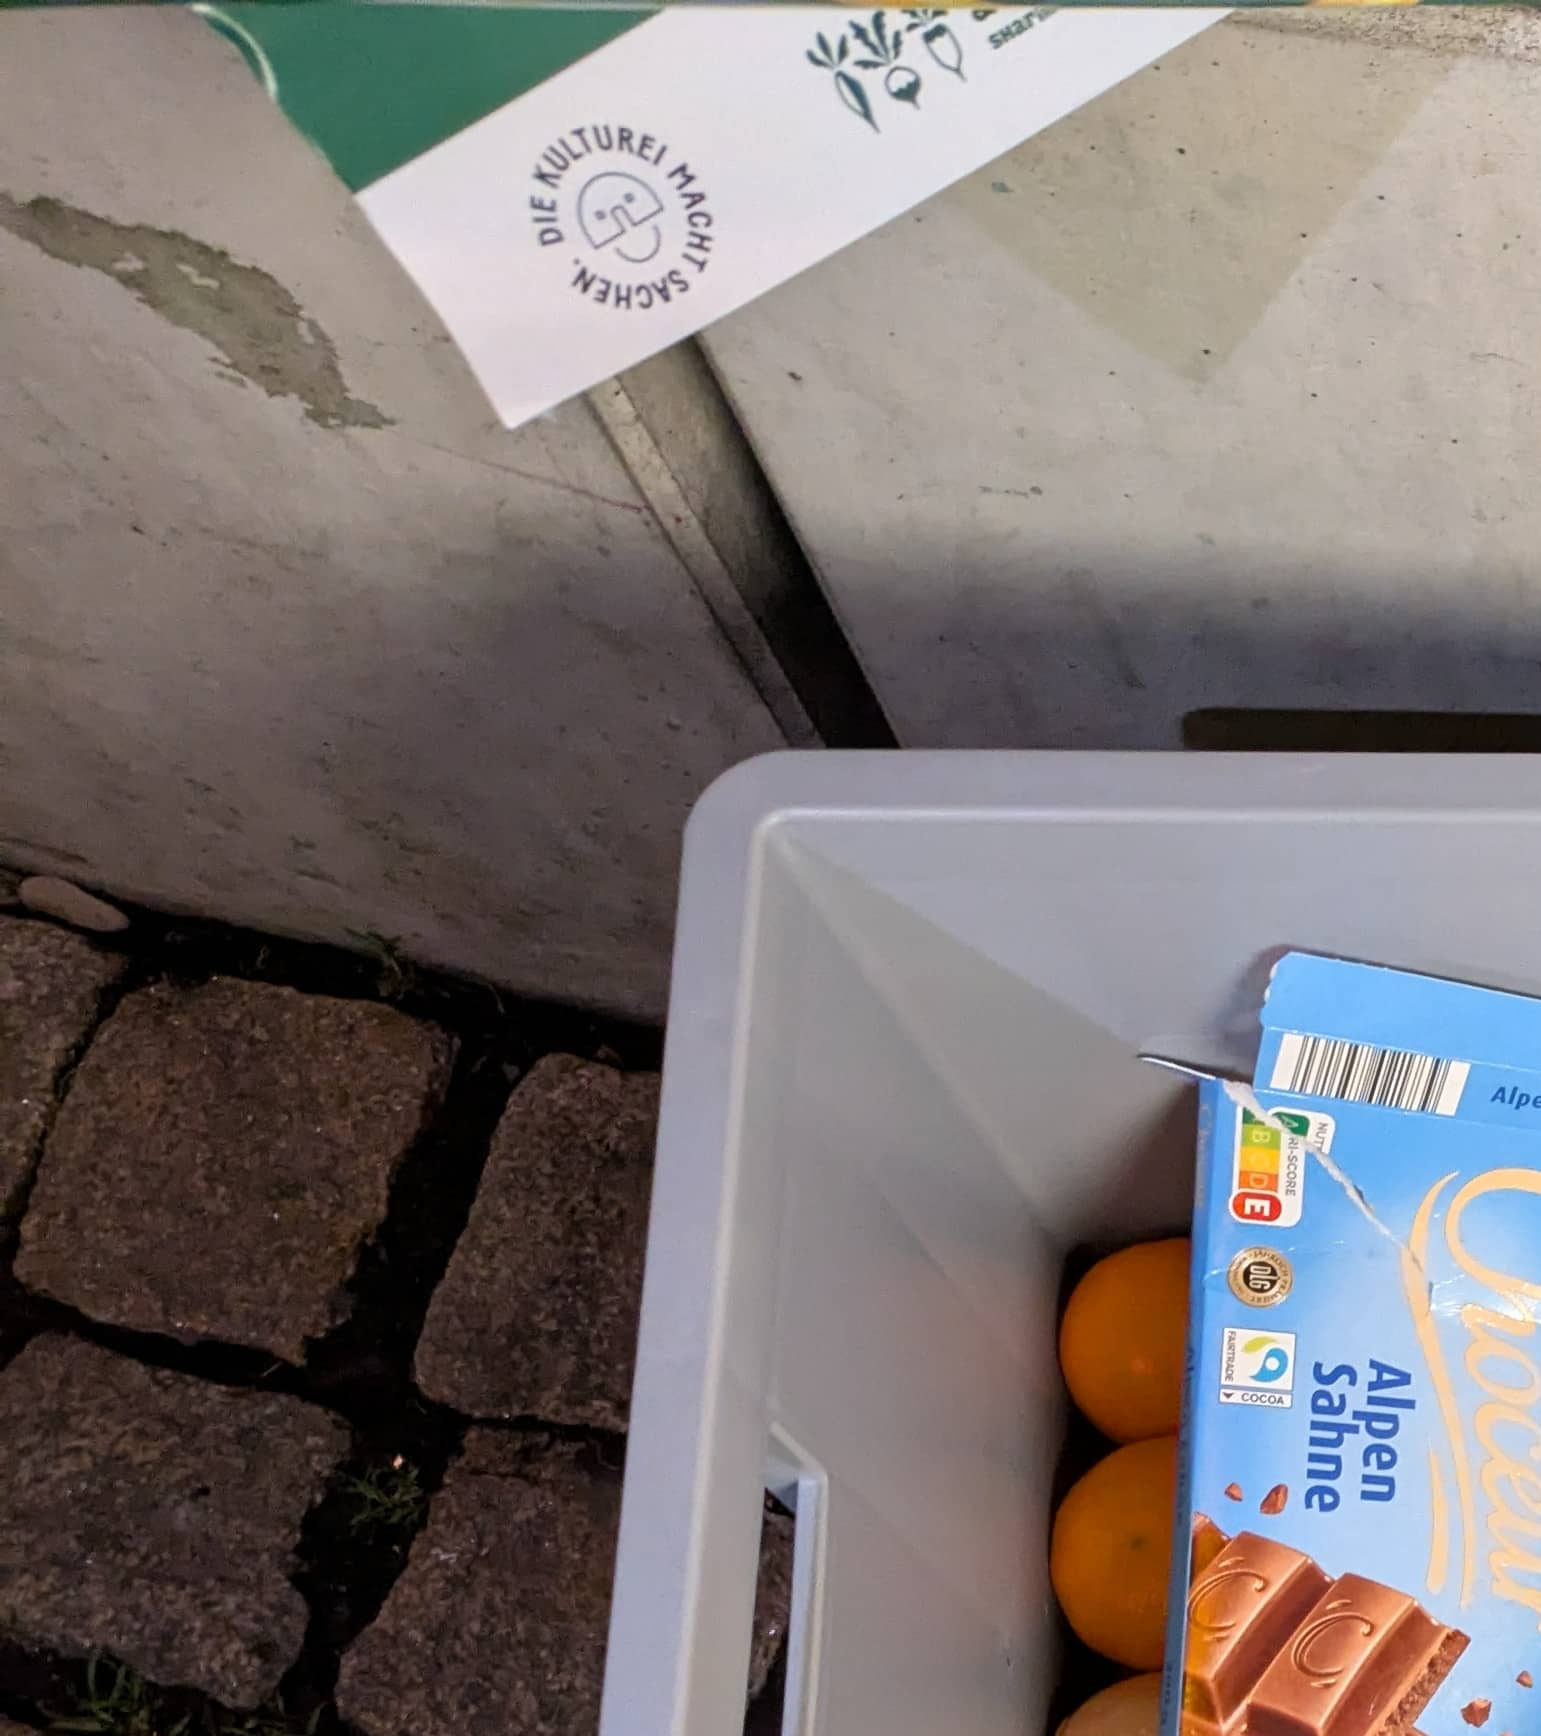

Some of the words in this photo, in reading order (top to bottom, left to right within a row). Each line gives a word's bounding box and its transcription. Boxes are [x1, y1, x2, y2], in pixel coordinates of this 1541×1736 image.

[532, 124, 668, 189] KULTUREI
[530, 195, 564, 246] DIE
[667, 162, 715, 273] MACHT
[1252, 1129, 1271, 1143] B
[1249, 1173, 1269, 1189] D
[1244, 1198, 1271, 1217] E
[1249, 1264, 1280, 1289] DLG
[1225, 1331, 1237, 1382] FAIRTRADE
[1241, 1393, 1285, 1405] COCOA
[1305, 1361, 1360, 1513] Sahne
[1352, 1358, 1417, 1502] Alpen
